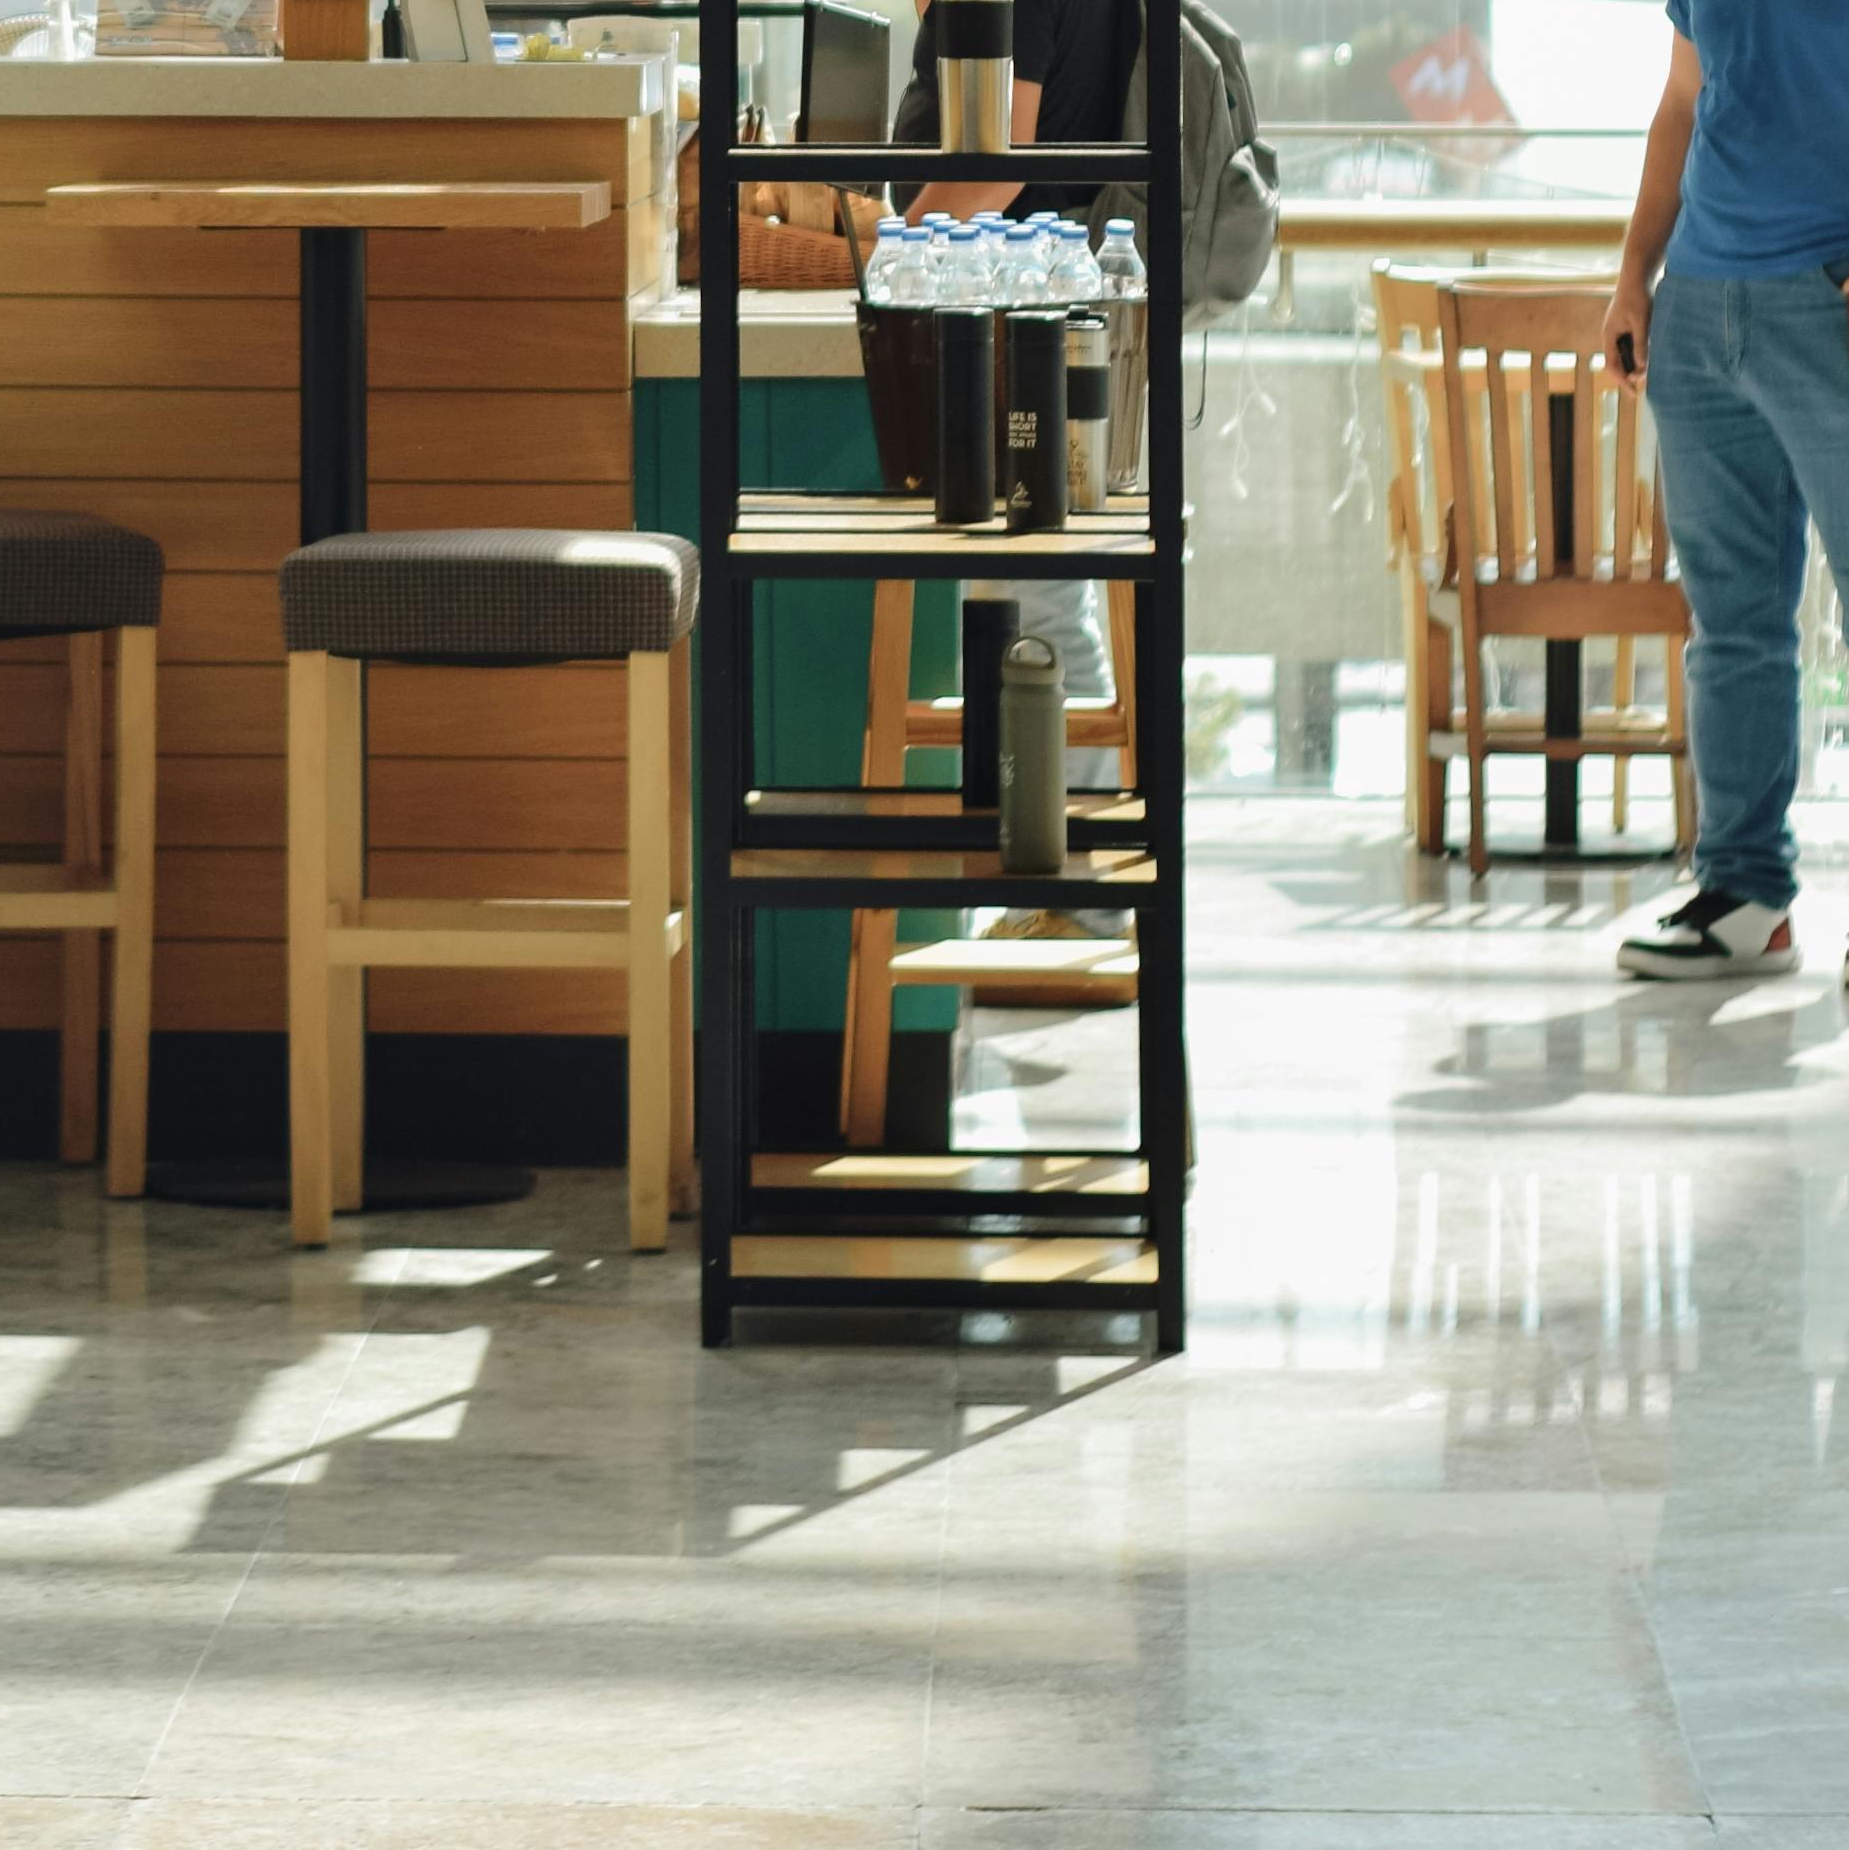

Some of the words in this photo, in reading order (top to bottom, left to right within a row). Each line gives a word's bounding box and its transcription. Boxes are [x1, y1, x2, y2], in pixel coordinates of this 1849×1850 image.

[1408, 54, 1471, 104] M
[1008, 412, 1025, 421] LIFE
[1028, 412, 1037, 421] IS
[1008, 422, 1037, 431] SHORT
[1008, 438, 1025, 448] FOR
[1027, 438, 1036, 448] IT
